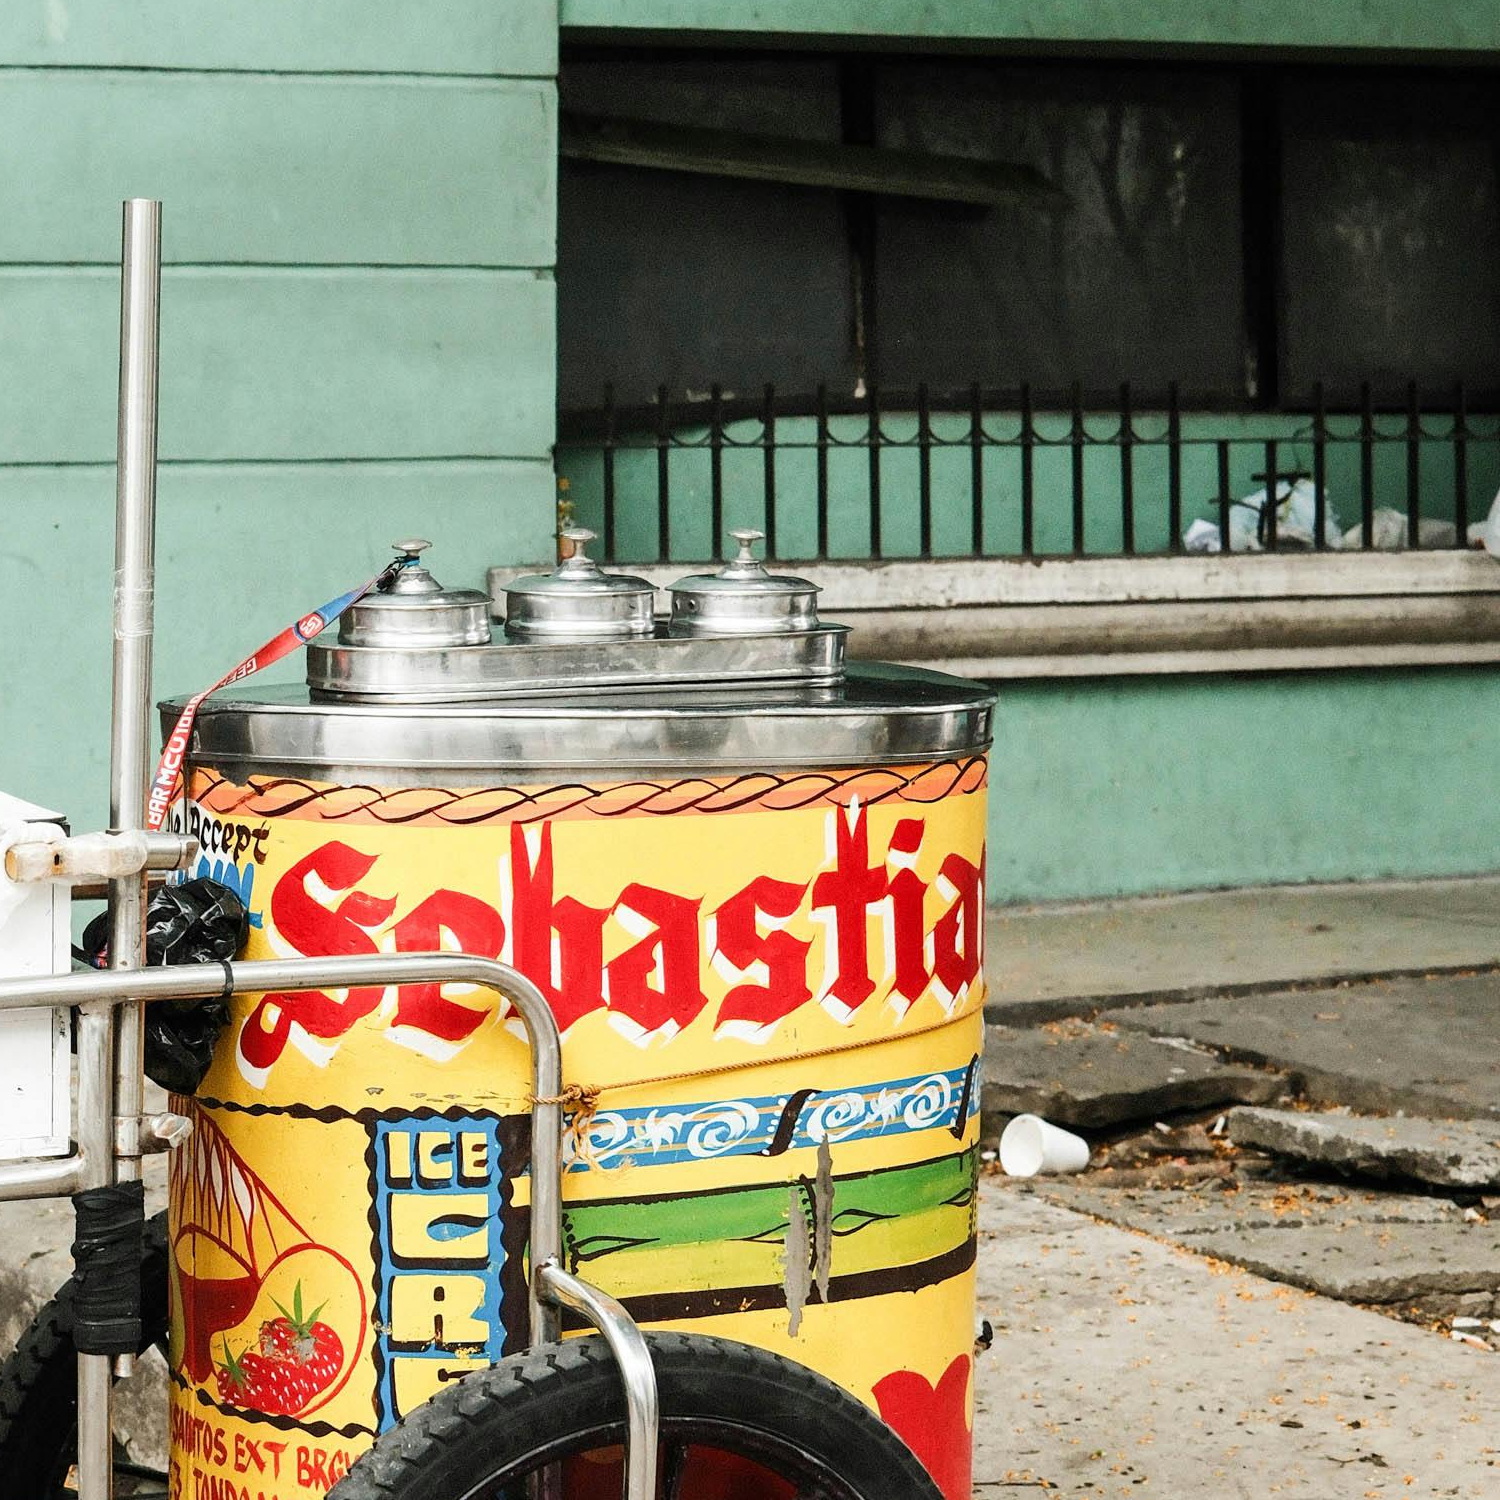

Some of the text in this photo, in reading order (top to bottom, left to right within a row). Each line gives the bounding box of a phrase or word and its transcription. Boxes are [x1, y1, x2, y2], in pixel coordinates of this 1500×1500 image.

[239, 805, 986, 1072] Sebastia
[385, 1132, 492, 1188] ICE
[233, 1432, 290, 1480] EXT
